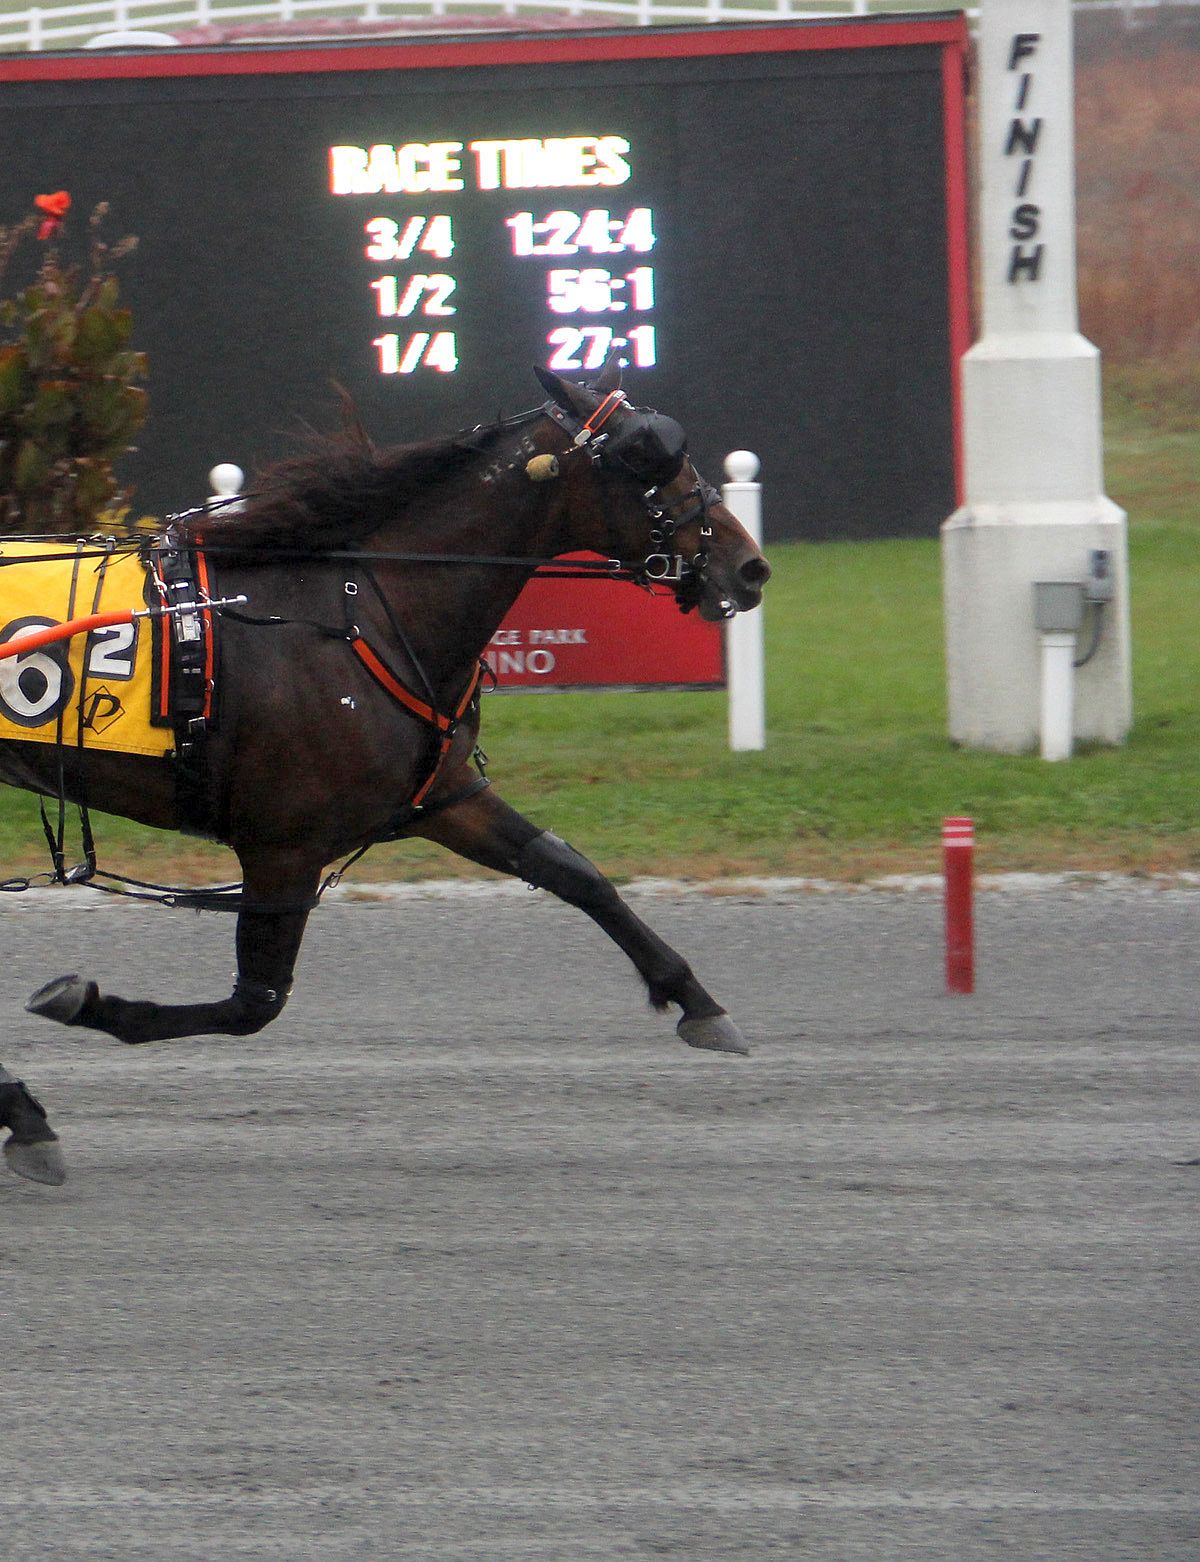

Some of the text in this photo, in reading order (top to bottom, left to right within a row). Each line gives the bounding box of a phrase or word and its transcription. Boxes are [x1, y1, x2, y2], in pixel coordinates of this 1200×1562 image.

[330, 136, 631, 194] RACE TIMES
[1003, 33, 1046, 285] FINISH
[364, 207, 656, 260] 3/4 1:24:4
[370, 266, 655, 317] 1/2 56:1
[370, 325, 656, 374] 1/4 27:1
[88, 621, 135, 676] 2
[483, 649, 556, 675] INO
[528, 628, 588, 645] PARK
